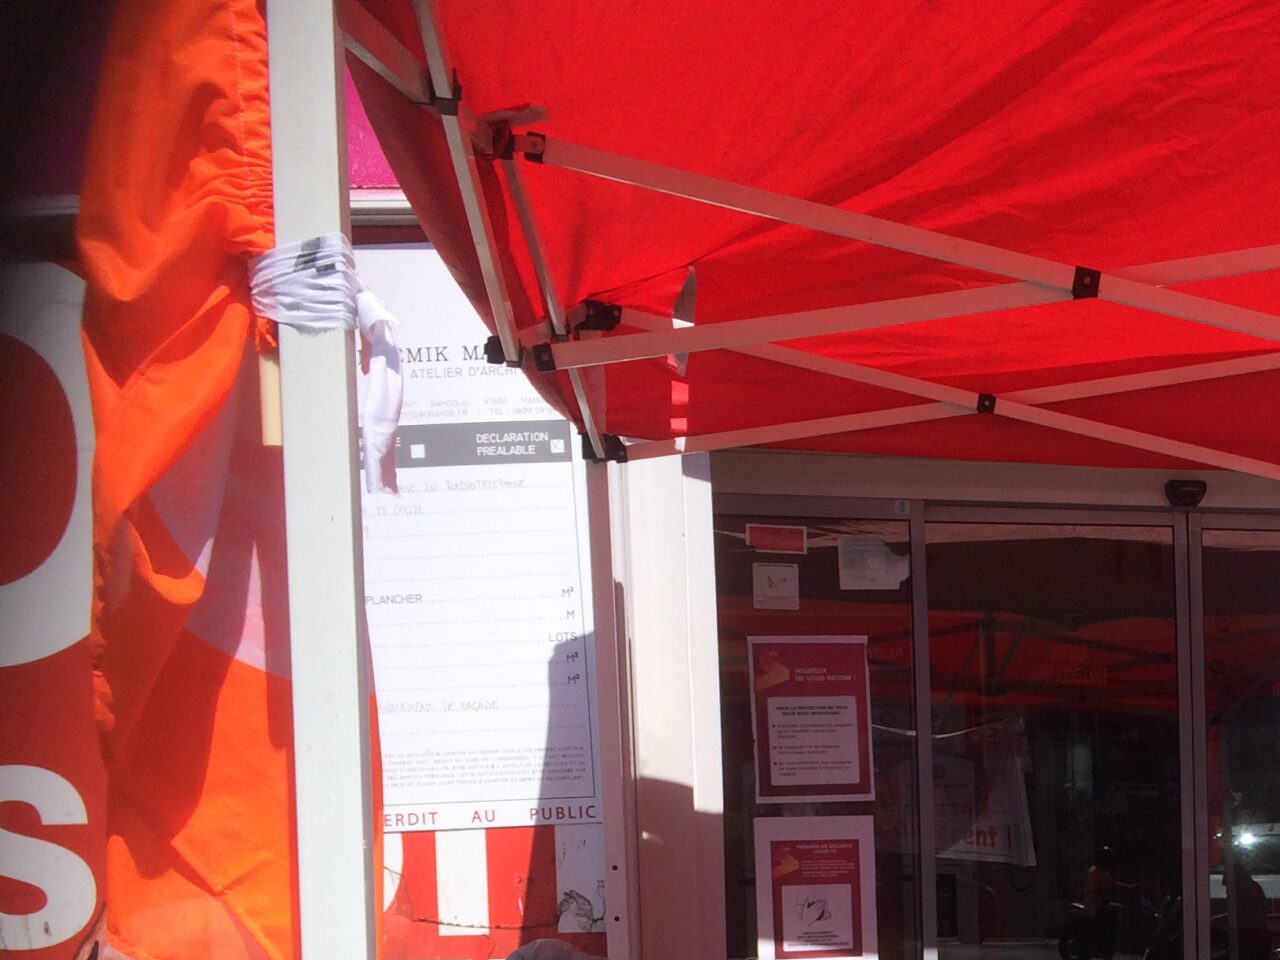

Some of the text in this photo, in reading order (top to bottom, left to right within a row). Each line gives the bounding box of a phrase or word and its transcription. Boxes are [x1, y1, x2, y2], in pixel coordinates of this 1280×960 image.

[411, 367, 463, 379] ATELIER
[476, 431, 549, 443] DECLARATION
[476, 445, 536, 456] PREALABLE
[365, 593, 423, 605] PLANCHER
[548, 632, 577, 642] LOTS
[471, 808, 496, 823] AU
[529, 805, 597, 820] PUBLIC
